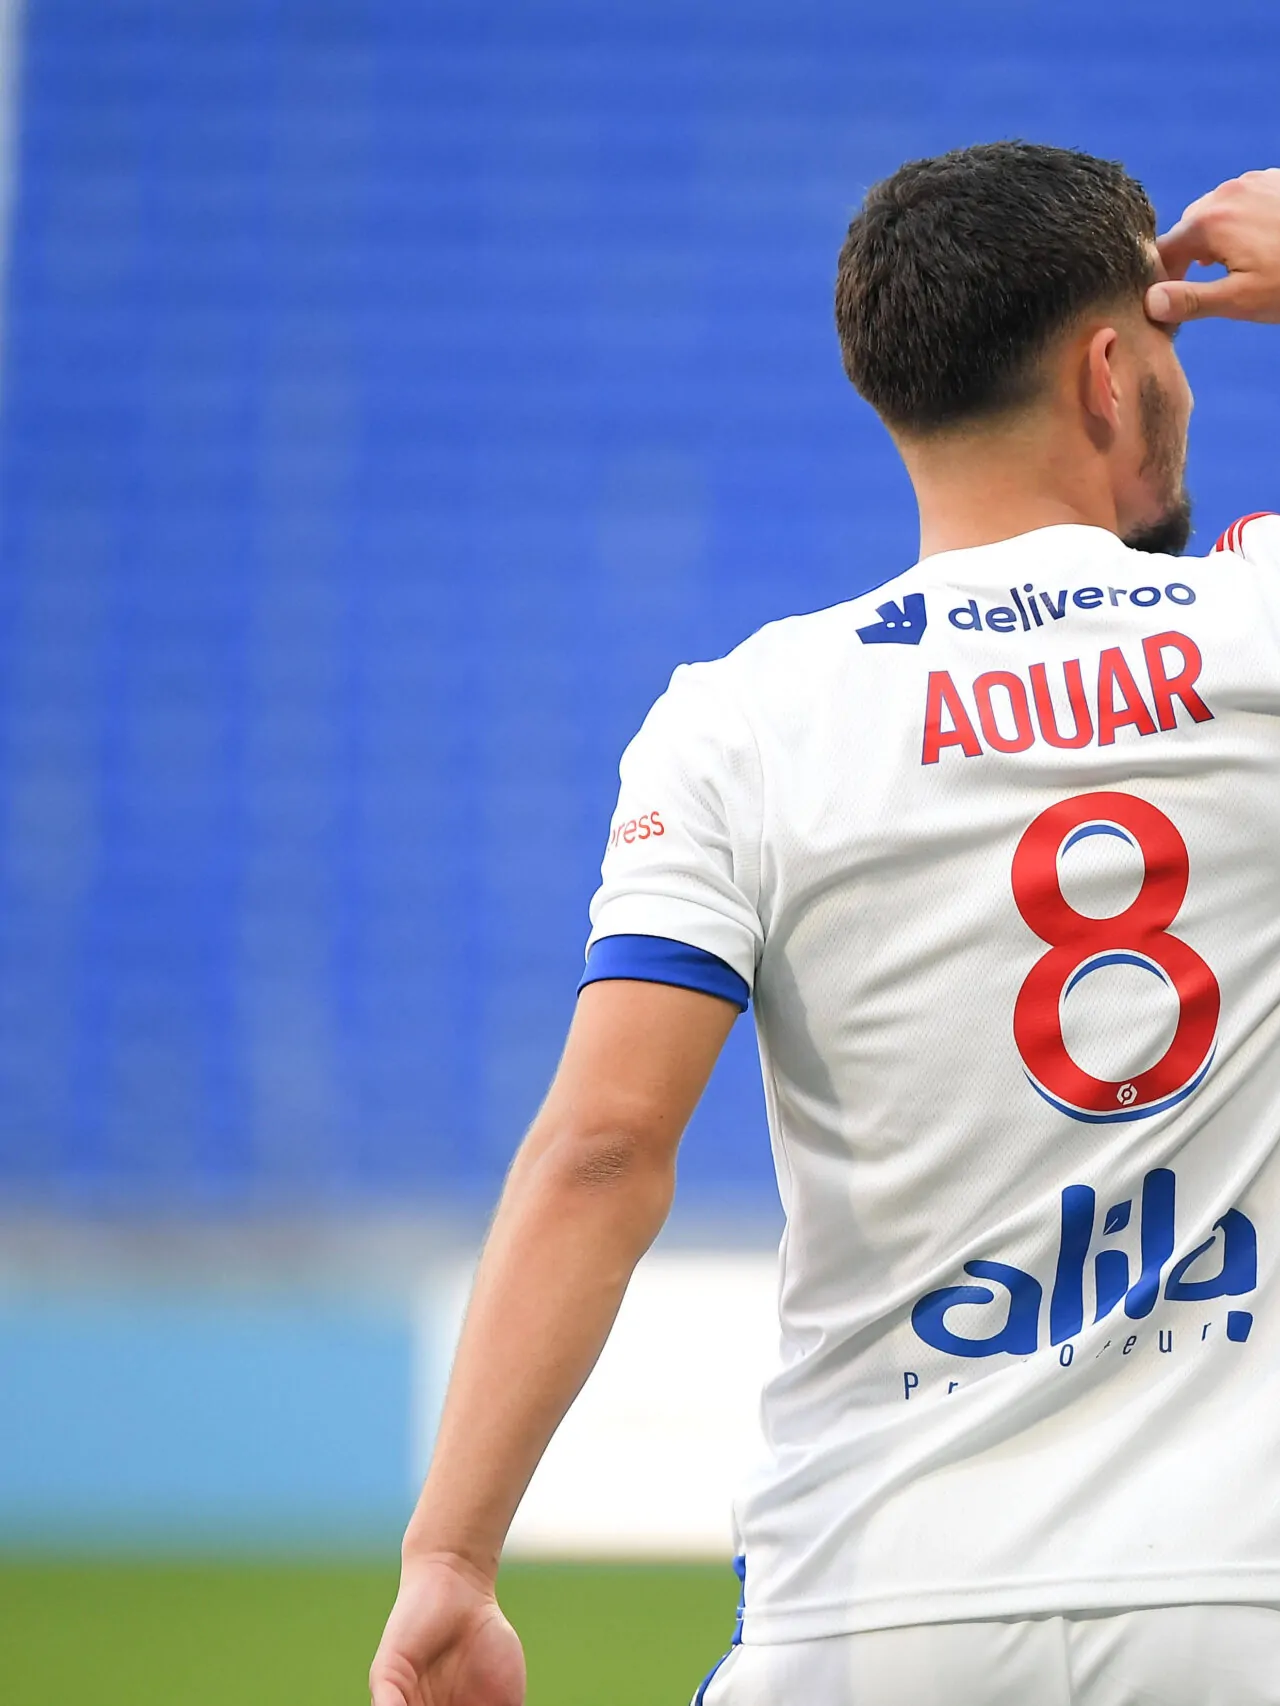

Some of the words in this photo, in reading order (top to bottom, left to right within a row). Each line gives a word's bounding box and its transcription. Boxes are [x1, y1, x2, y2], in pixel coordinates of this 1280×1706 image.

[948, 582, 1197, 632] deliveroo
[921, 630, 1215, 766] AOUAR
[608, 810, 665, 852] ress
[1011, 791, 1220, 1124] 8
